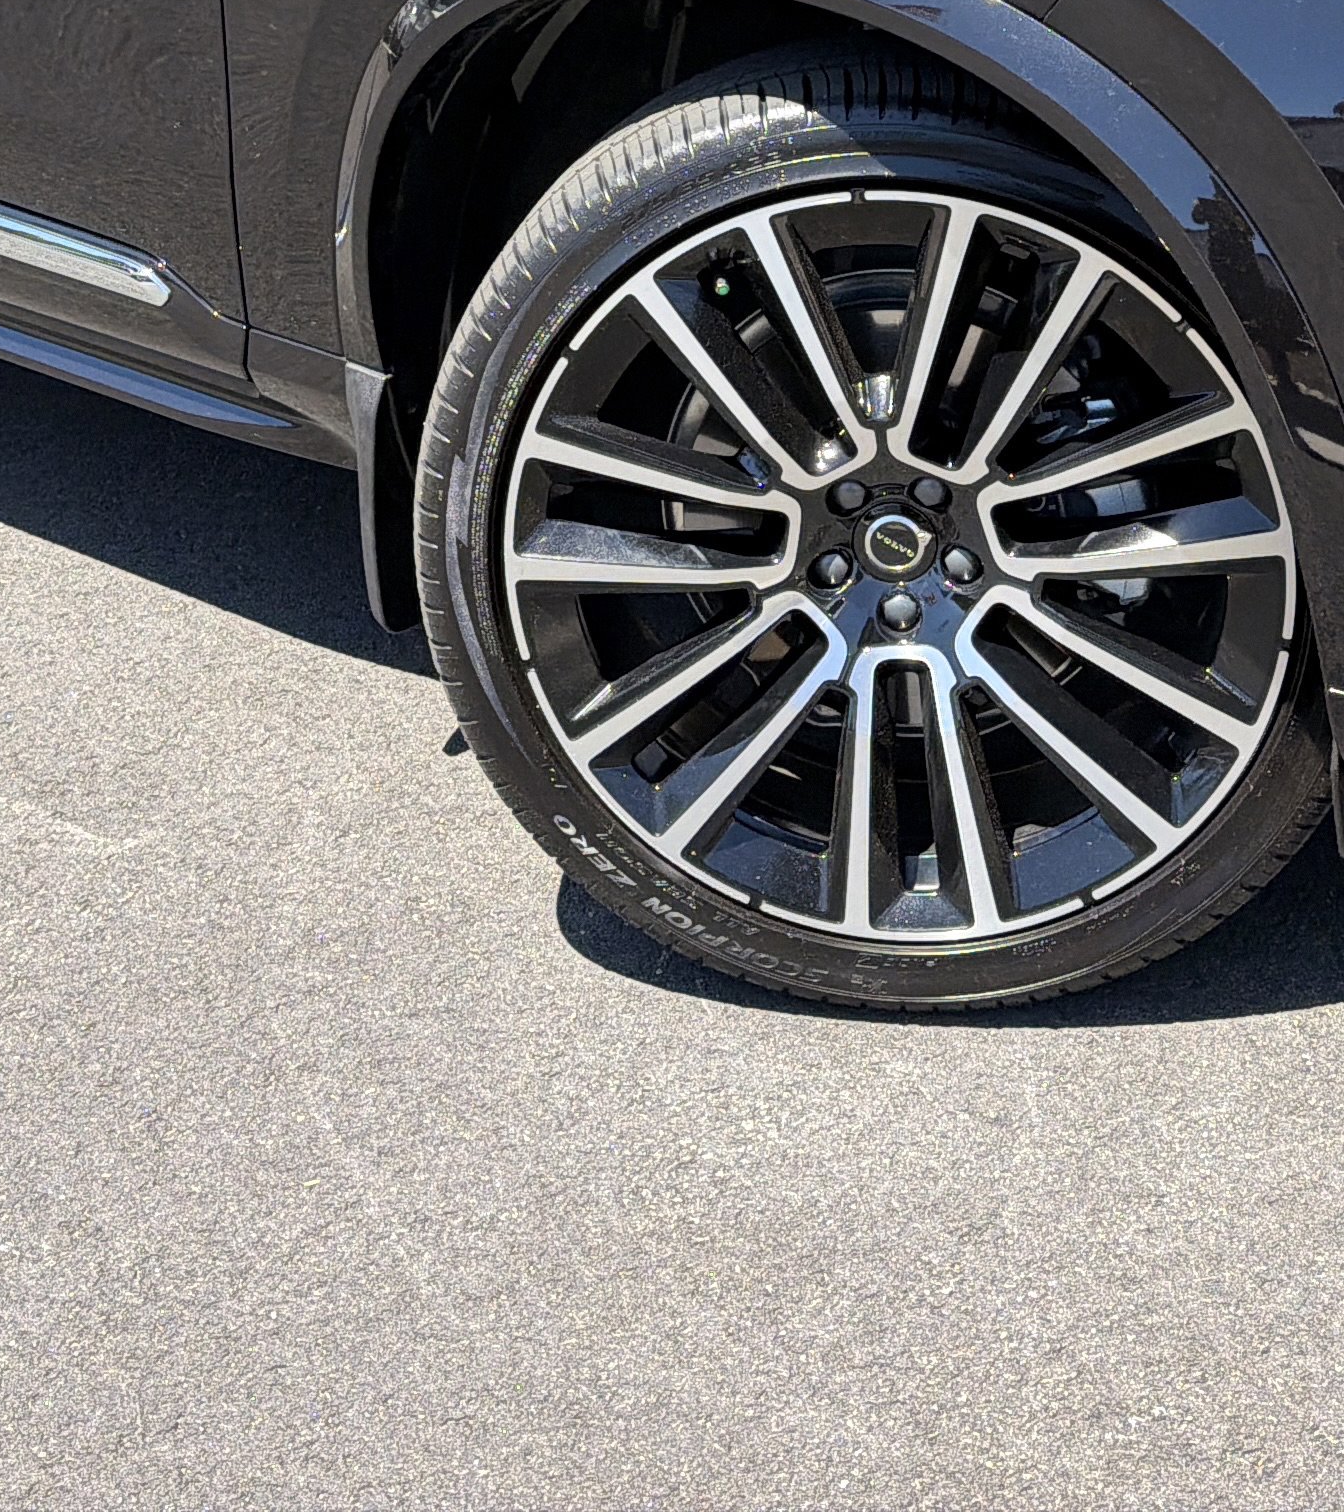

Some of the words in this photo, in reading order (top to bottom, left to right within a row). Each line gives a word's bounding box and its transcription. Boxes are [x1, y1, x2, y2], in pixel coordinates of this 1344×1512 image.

[876, 531, 915, 558] VOLVO
[553, 814, 637, 888] ZERO
[641, 896, 829, 984] SCORPION
